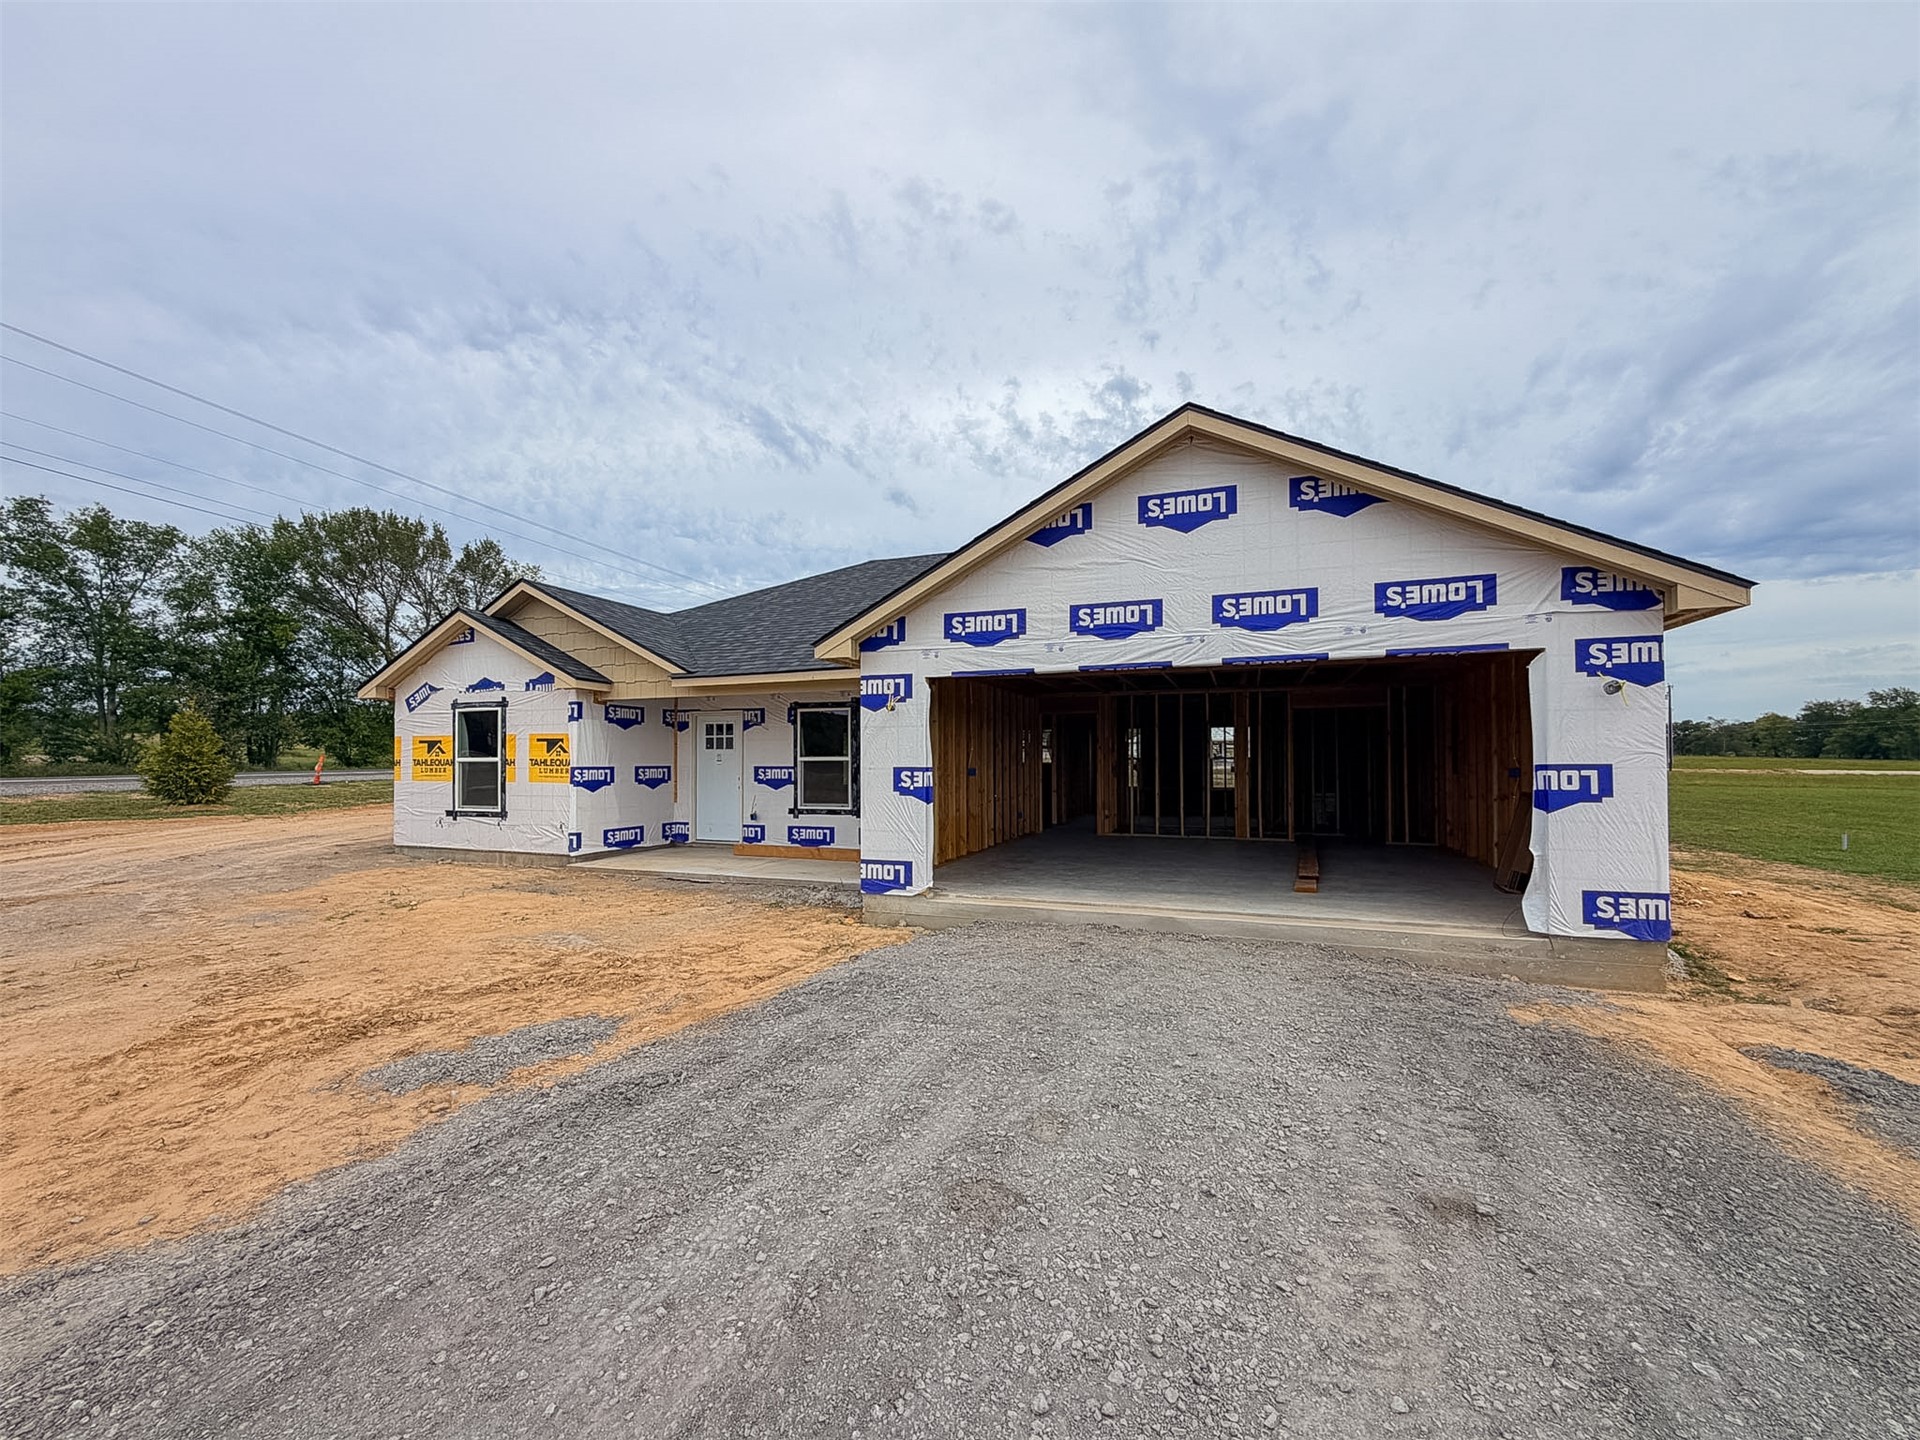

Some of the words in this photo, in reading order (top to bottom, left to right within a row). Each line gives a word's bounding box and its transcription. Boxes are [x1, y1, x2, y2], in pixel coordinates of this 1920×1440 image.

[1147, 491, 1226, 519] LOWE'S
[1222, 593, 1306, 619] LOWE'S
[1386, 580, 1483, 609] LOWE'S
[952, 613, 1018, 636] LOWE'S
[1078, 604, 1153, 628] LOWE'S
[1589, 641, 1664, 668] WE'S
[608, 707, 641, 722] LOWE'S
[574, 769, 610, 783] LOWE'S
[638, 768, 667, 780] LOWE'S
[758, 768, 794, 780] LOWE'S
[608, 829, 640, 844] LOWE'S
[792, 828, 830, 842] LOWE'S
[1596, 896, 1671, 922] WE'S
